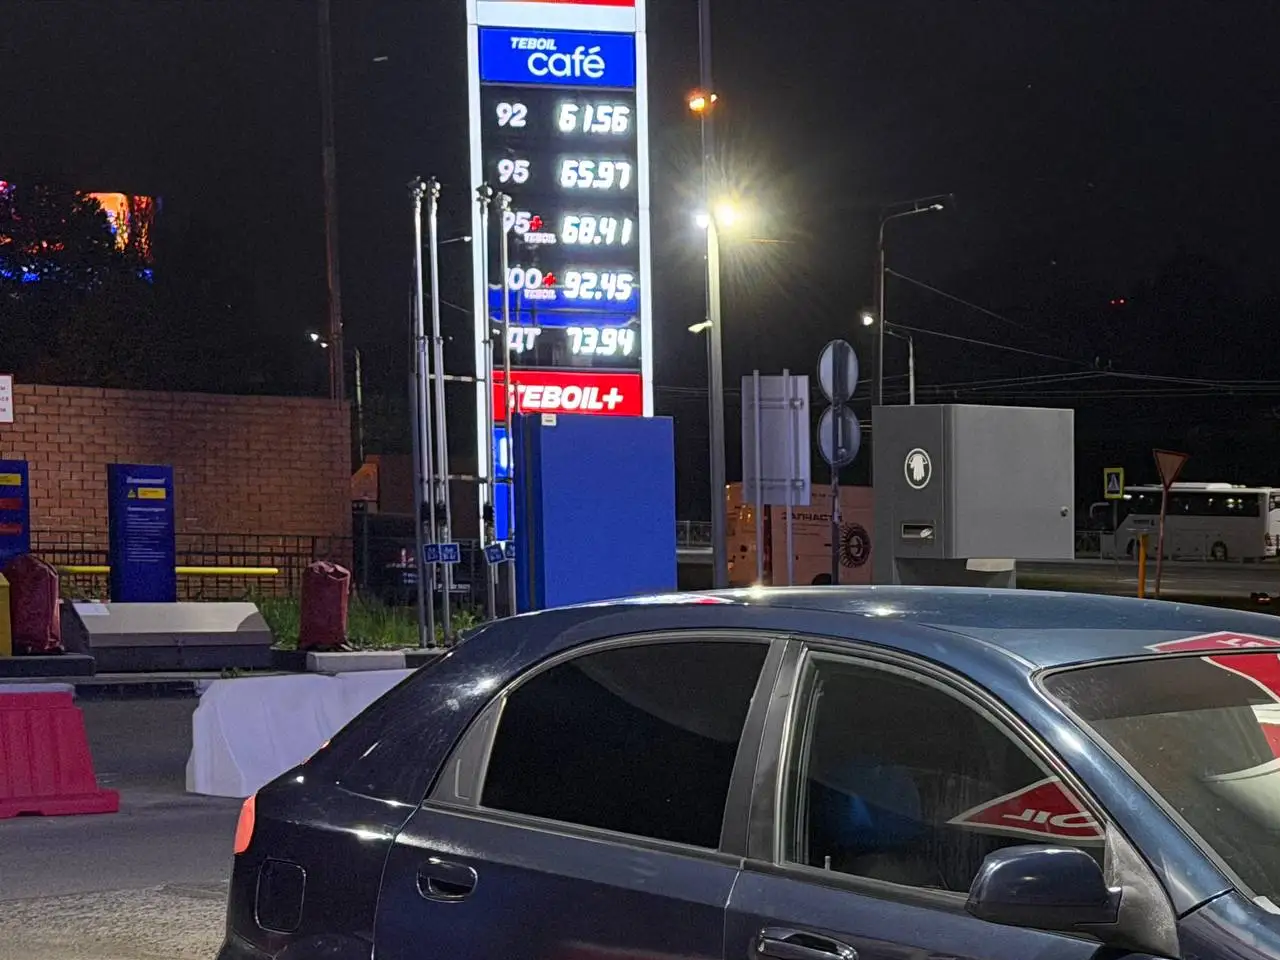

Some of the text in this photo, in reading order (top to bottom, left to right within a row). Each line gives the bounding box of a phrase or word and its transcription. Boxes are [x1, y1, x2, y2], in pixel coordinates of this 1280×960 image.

[510, 37, 557, 50] TEBOIL
[527, 46, 605, 78] café
[496, 103, 630, 133] 92 61.56
[498, 159, 631, 189] 95 65.97
[562, 216, 632, 245] 68.41
[563, 271, 633, 300] 92.45
[566, 327, 634, 355] 73.94
[781, 511, 842, 522] ЗАПЧАСТ
